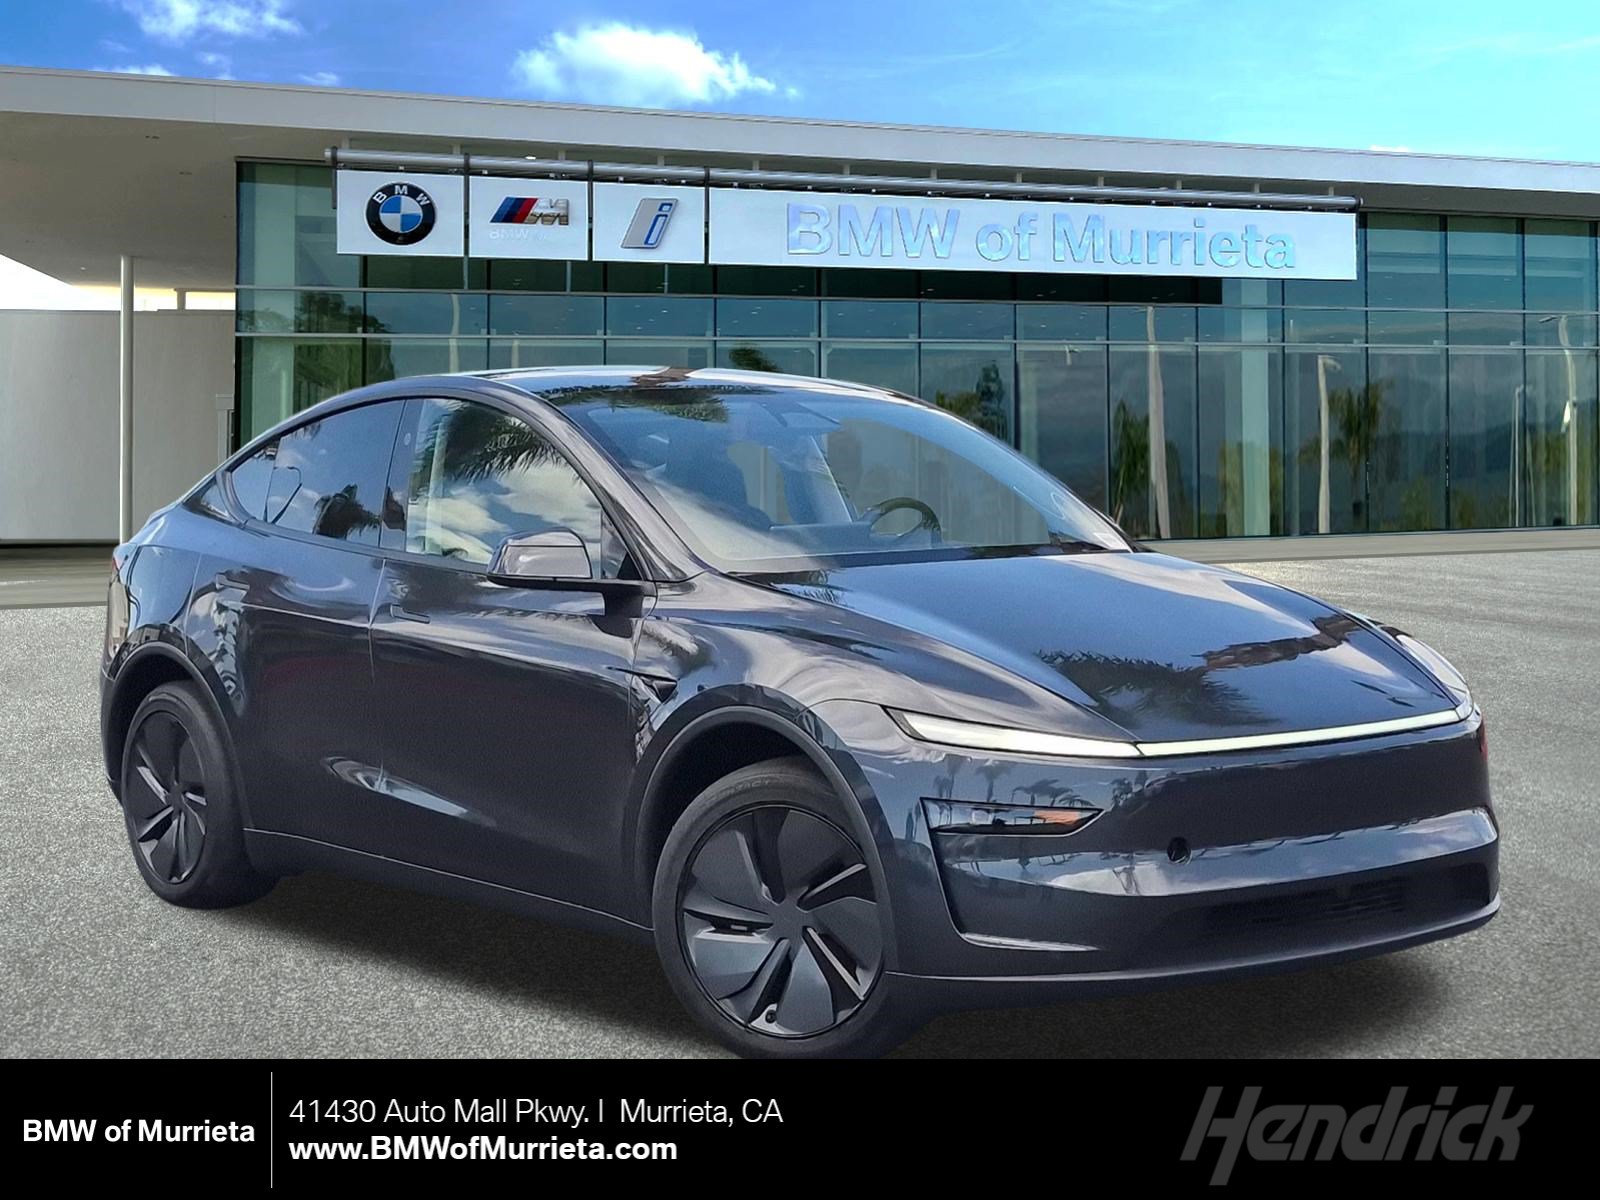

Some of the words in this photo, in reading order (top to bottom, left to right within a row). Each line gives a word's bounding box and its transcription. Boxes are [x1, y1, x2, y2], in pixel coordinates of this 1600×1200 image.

[787, 202, 961, 259] BMW
[975, 211, 1040, 262] of
[1052, 212, 1296, 270] Murrieta
